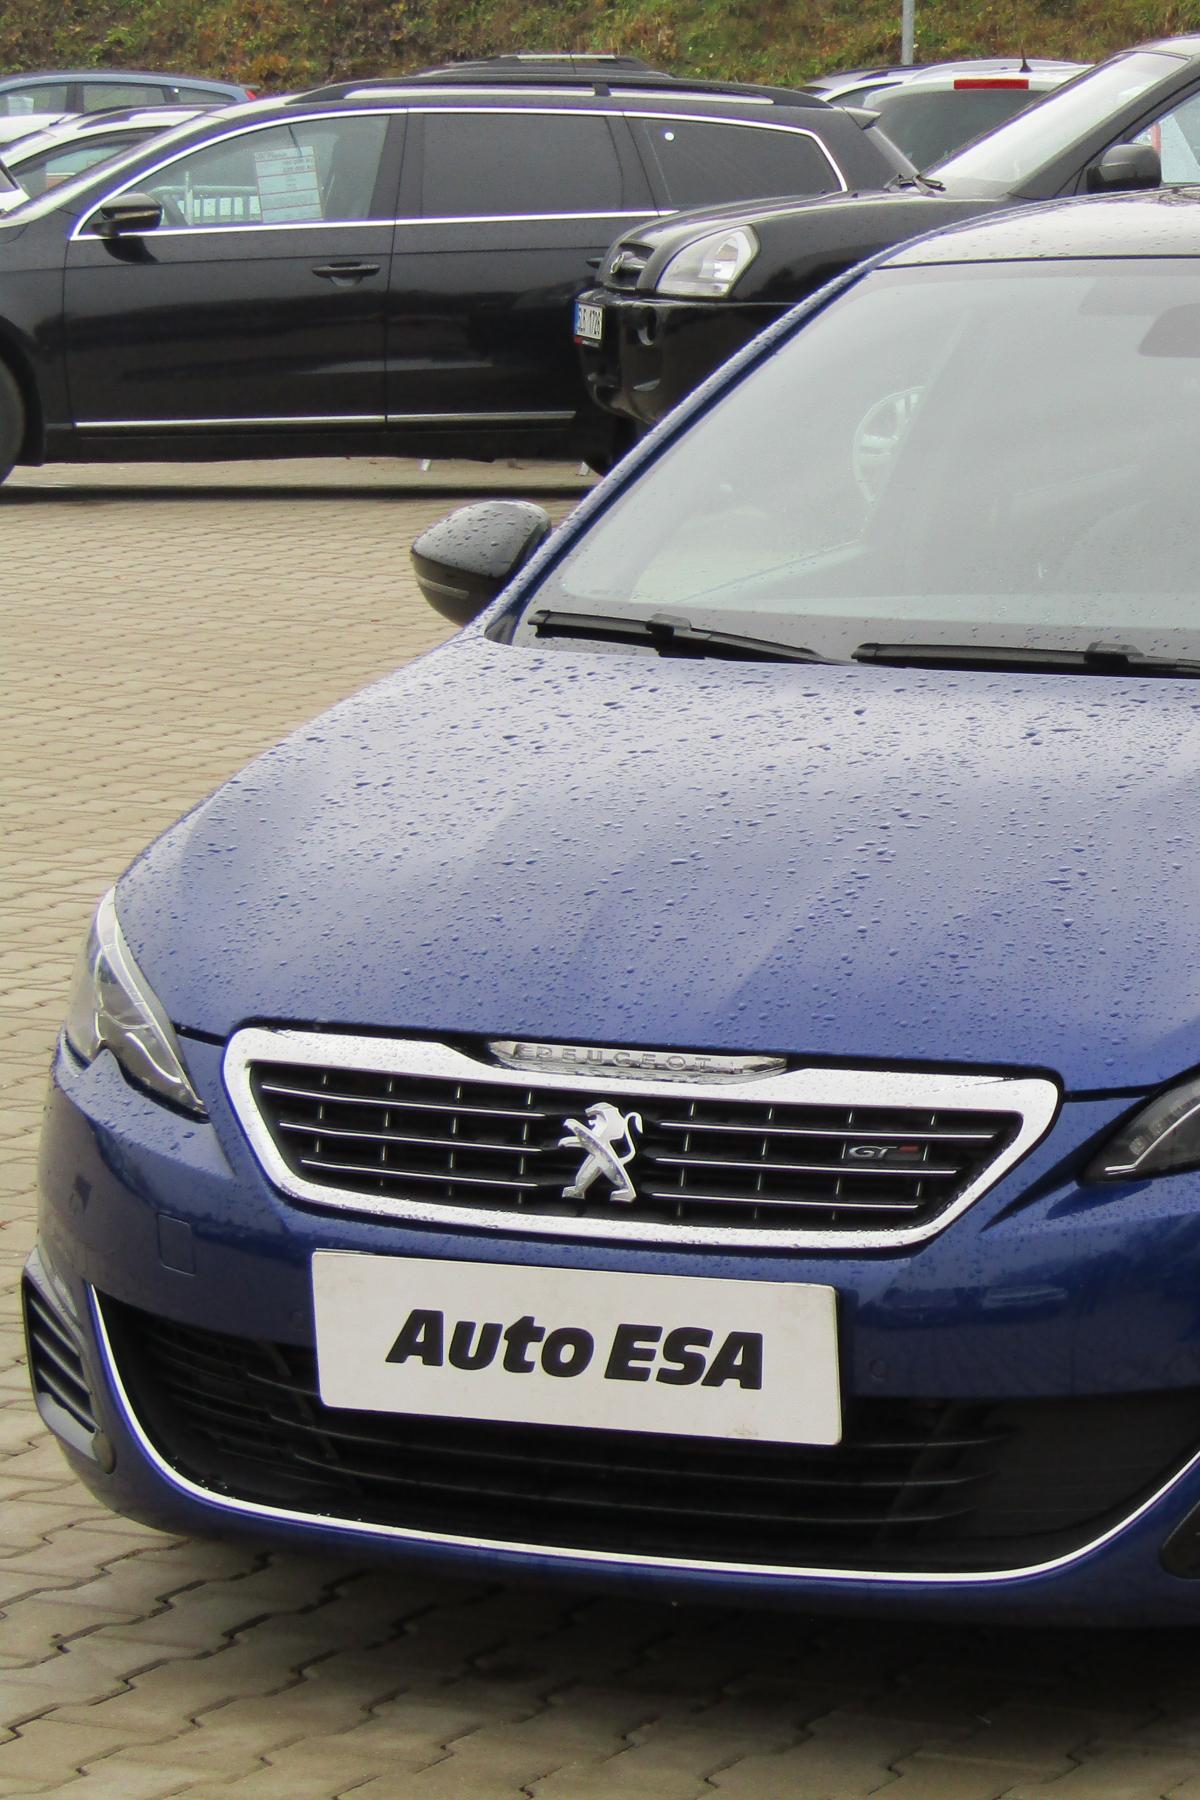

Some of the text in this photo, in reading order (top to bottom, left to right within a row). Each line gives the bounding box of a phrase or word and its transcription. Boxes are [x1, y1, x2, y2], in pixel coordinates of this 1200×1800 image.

[536, 1045, 712, 1072] PEUGEOT
[384, 1308, 764, 1390] Auto ESA
